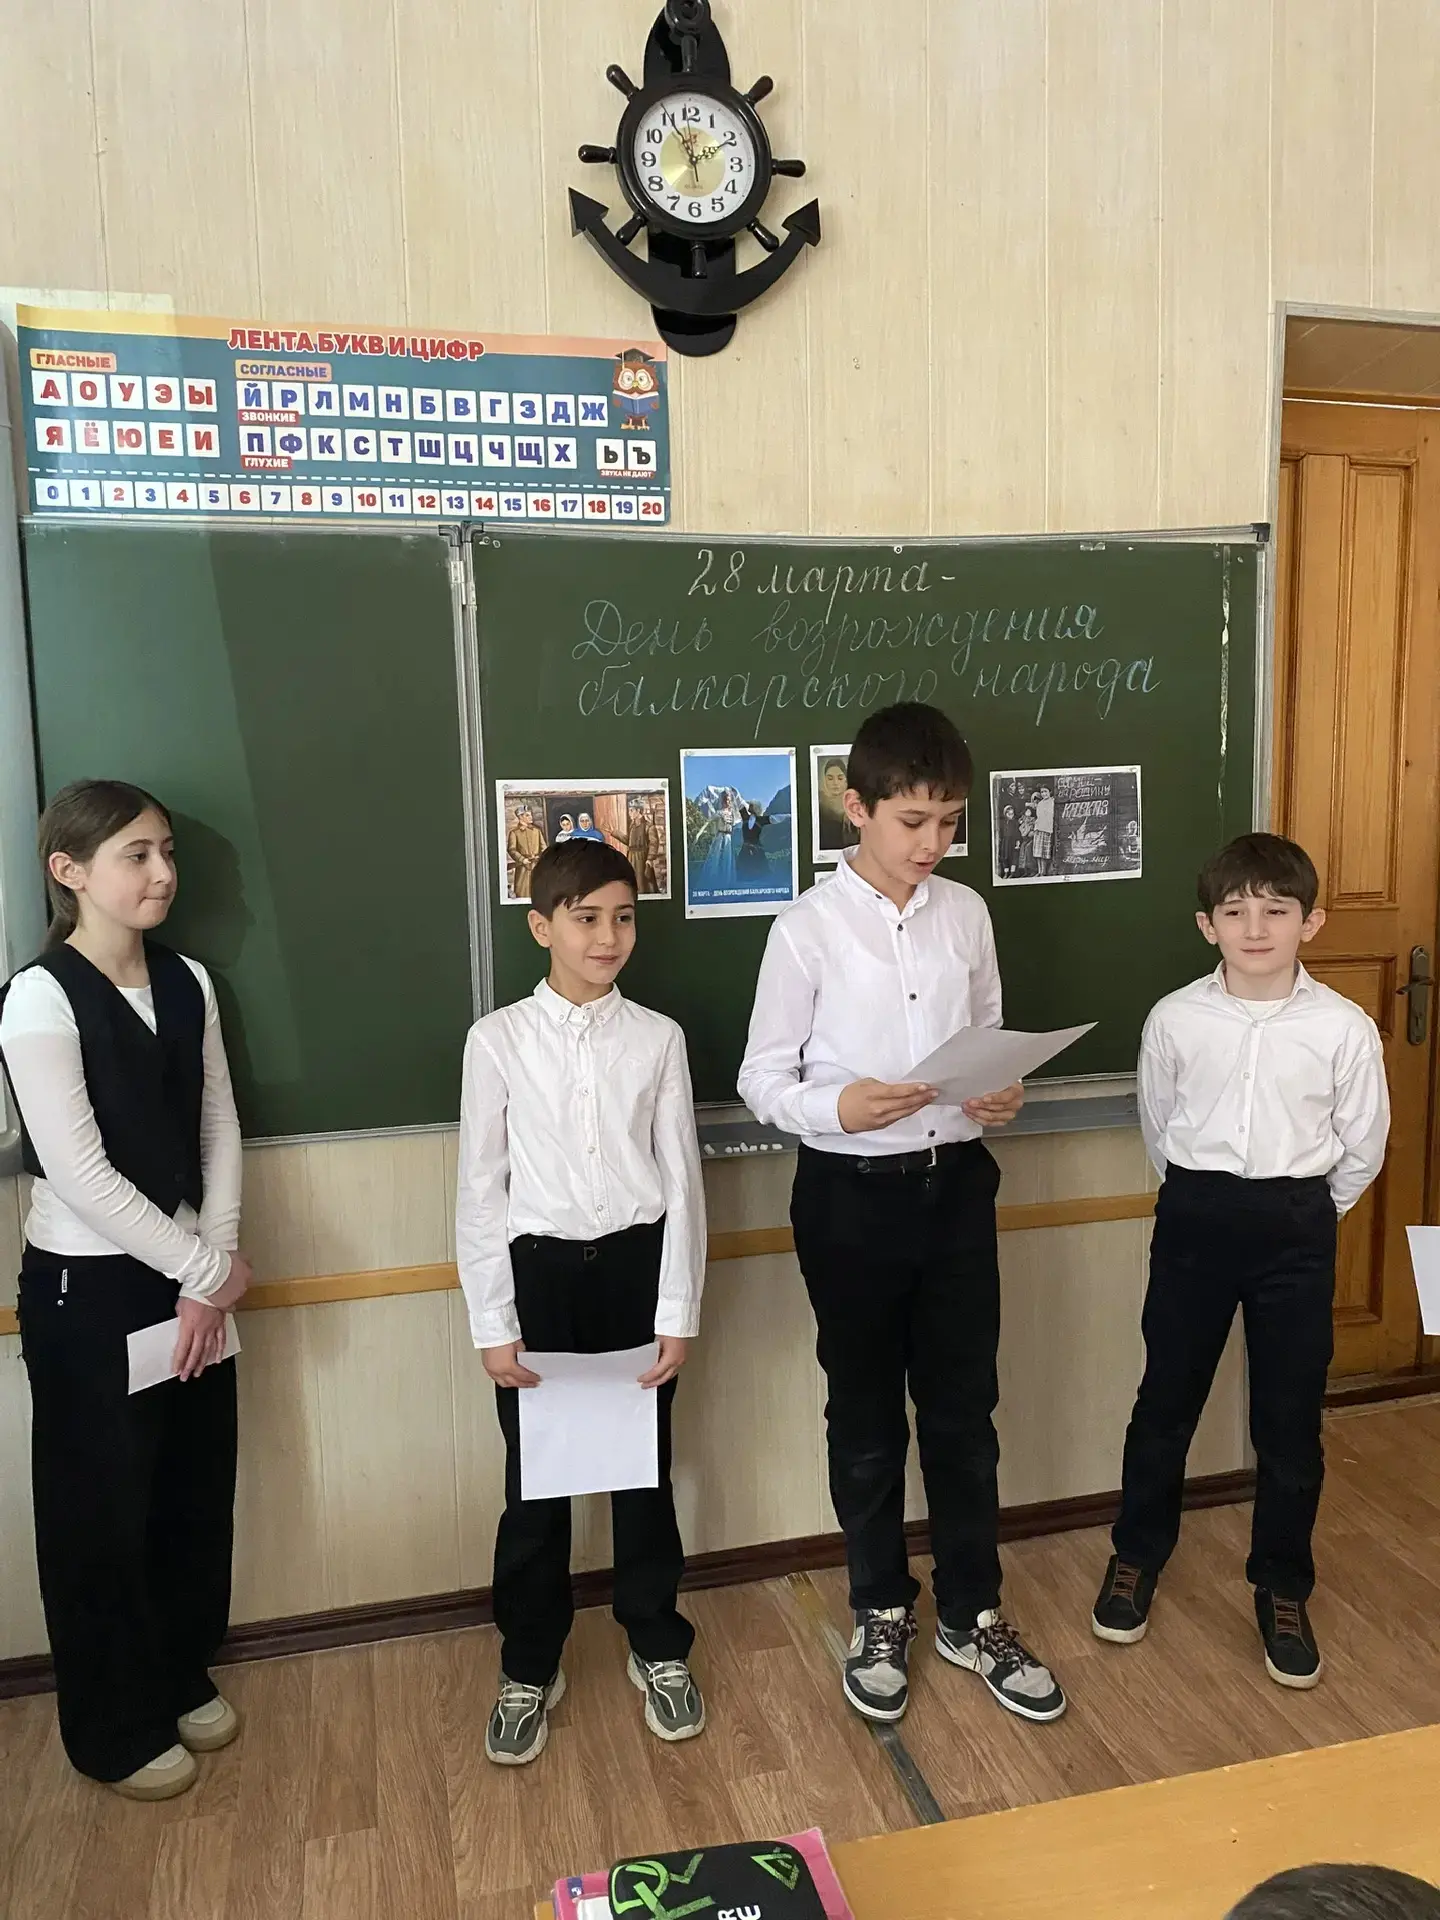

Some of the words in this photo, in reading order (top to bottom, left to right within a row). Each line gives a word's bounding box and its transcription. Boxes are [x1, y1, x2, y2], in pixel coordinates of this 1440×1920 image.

[662, 112, 676, 128] 11
[682, 106, 700, 122] 12
[708, 113, 715, 128] 1
[646, 128, 663, 144] 10
[723, 131, 737, 146] 2
[641, 152, 656, 167] 9
[730, 157, 743, 172] 3
[648, 175, 664, 192] 8
[724, 179, 738, 194] 4
[667, 194, 680, 211] 7
[688, 201, 702, 218] 6
[711, 196, 724, 212] 5
[229, 329, 315, 351] ЛЕНТА
[318, 333, 385, 355] БУКВ
[389, 336, 406, 357] И
[411, 337, 485, 361] ЦИФР
[36, 353, 111, 368] ГЛАСНЫЕ
[240, 364, 327, 378] СОГЛАСНЫЕ
[41, 379, 61, 399] А
[79, 380, 98, 400] О
[118, 382, 135, 401] У
[154, 383, 172, 403] Э
[188, 385, 213, 405] Ы
[244, 383, 262, 407] Й
[281, 389, 298, 408] Р
[315, 391, 333, 410] Л
[349, 392, 369, 411] М
[385, 394, 402, 412] Н
[420, 396, 436, 414] Б
[454, 397, 471, 416] В
[489, 399, 502, 417] Г
[520, 400, 536, 419] З
[551, 402, 571, 423] Д
[581, 402, 605, 421] Ж
[241, 411, 296, 423] ЗВОНКИЕ
[46, 426, 64, 446] Я
[84, 422, 99, 447] Ё
[117, 428, 142, 448] Ю
[158, 429, 175, 449] Е
[194, 431, 213, 451] И
[247, 432, 265, 452] П
[279, 433, 303, 453] Ф
[318, 434, 335, 454] К
[354, 436, 370, 455] С
[388, 437, 403, 456] Т
[419, 439, 441, 457] Ш
[454, 440, 473, 462] Ц
[489, 441, 504, 459] Ч
[518, 443, 542, 465] Щ
[554, 443, 571, 462] Х
[604, 446, 618, 464] Ь
[632, 447, 650, 465] Ъ
[244, 457, 289, 468] ГЛУХИЕ
[47, 485, 59, 500] 0
[81, 487, 90, 501] 1
[113, 487, 125, 501] 2
[145, 488, 157, 502] 3
[176, 489, 189, 502] 4
[208, 490, 220, 504] 5
[239, 491, 251, 505] 6
[270, 491, 281, 505] 7
[301, 492, 312, 505] 8
[331, 493, 343, 506] 9
[357, 493, 376, 507] 10
[389, 494, 404, 507] 11
[418, 495, 435, 508] 12
[447, 496, 464, 509] 13
[476, 497, 494, 510] 14
[505, 498, 521, 511] 15
[533, 499, 551, 512] 16
[561, 500, 578, 513] 17
[588, 500, 606, 513] 18
[616, 501, 633, 514] 19
[642, 502, 662, 515] 20
[688, 549, 745, 595] 28
[757, 561, 932, 625] марта
[572, 599, 713, 660] День
[751, 599, 1105, 677] возрождения
[578, 661, 938, 740] балкарского
[972, 656, 1163, 727] народа
[1062, 800, 1109, 818] КАВКАЗ
